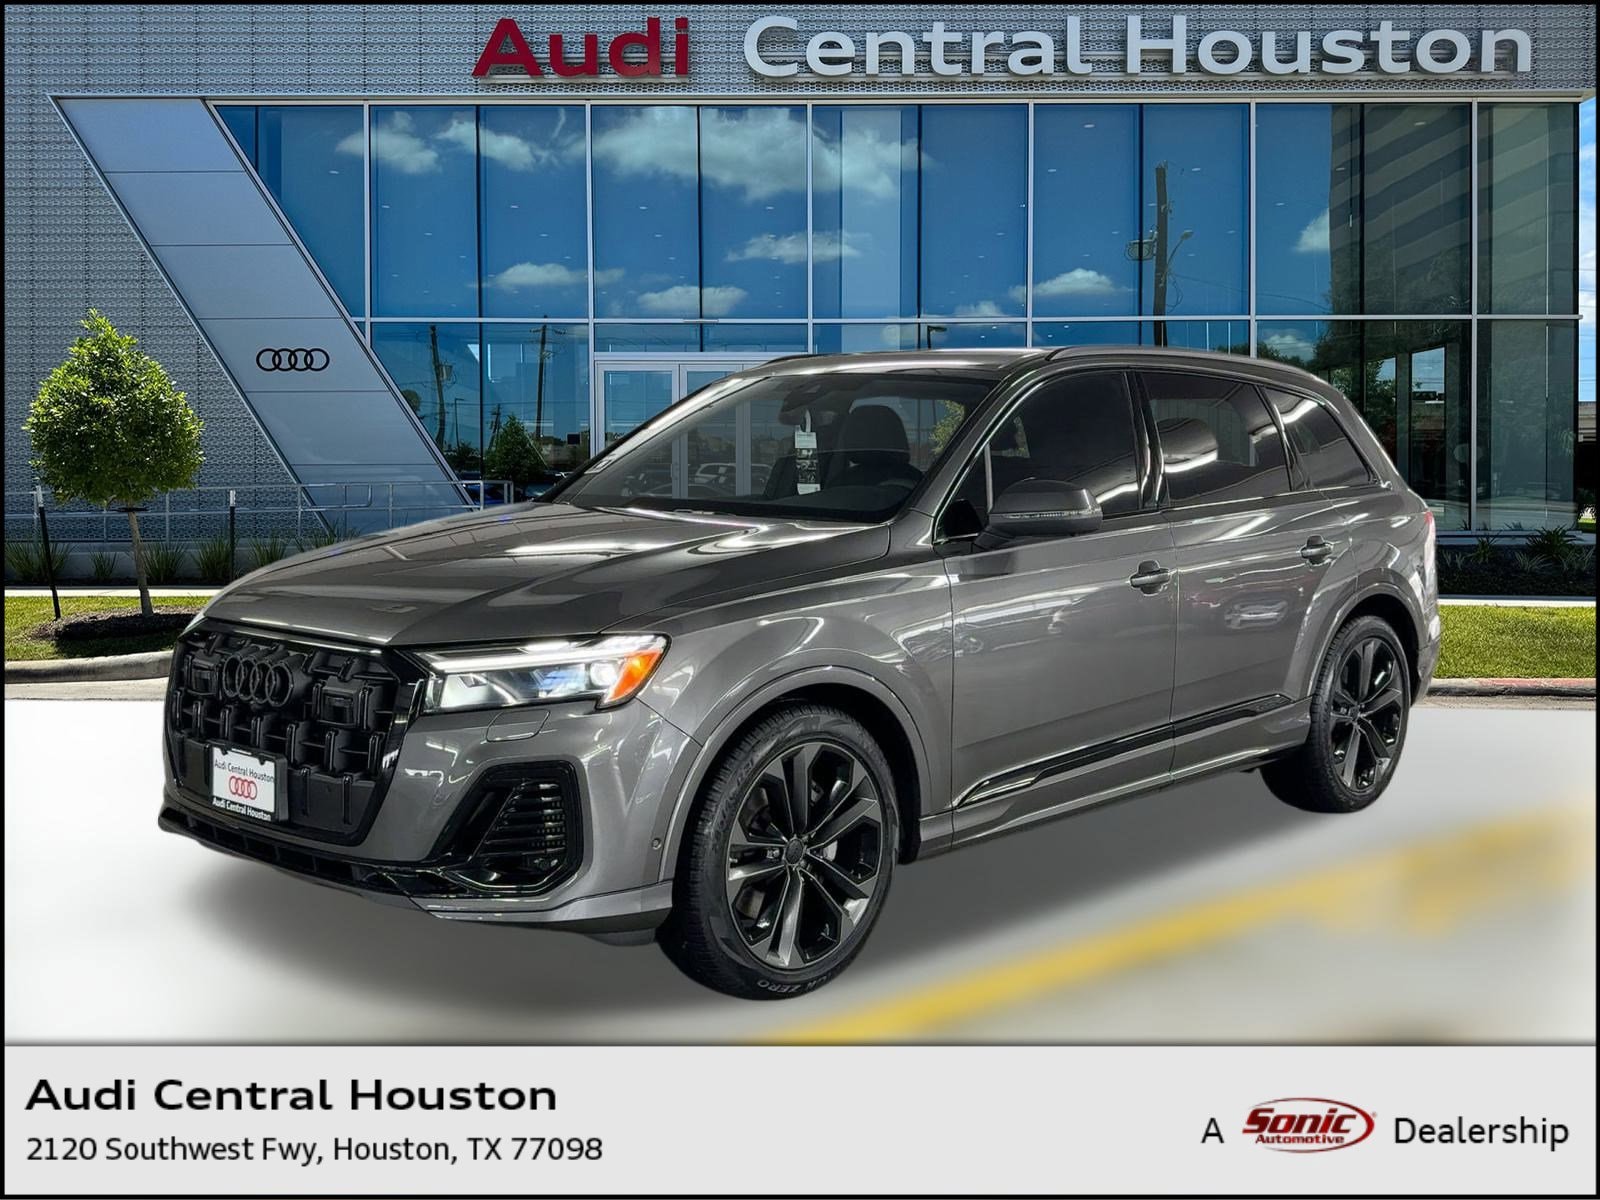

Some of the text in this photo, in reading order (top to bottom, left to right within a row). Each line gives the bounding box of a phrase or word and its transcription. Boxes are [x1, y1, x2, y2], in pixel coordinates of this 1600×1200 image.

[472, 15, 1532, 78] Audi Central Houston
[214, 760, 275, 782] Audi Central Houston
[212, 797, 272, 821] Audi Central Houston
[757, 979, 801, 993] ZERO
